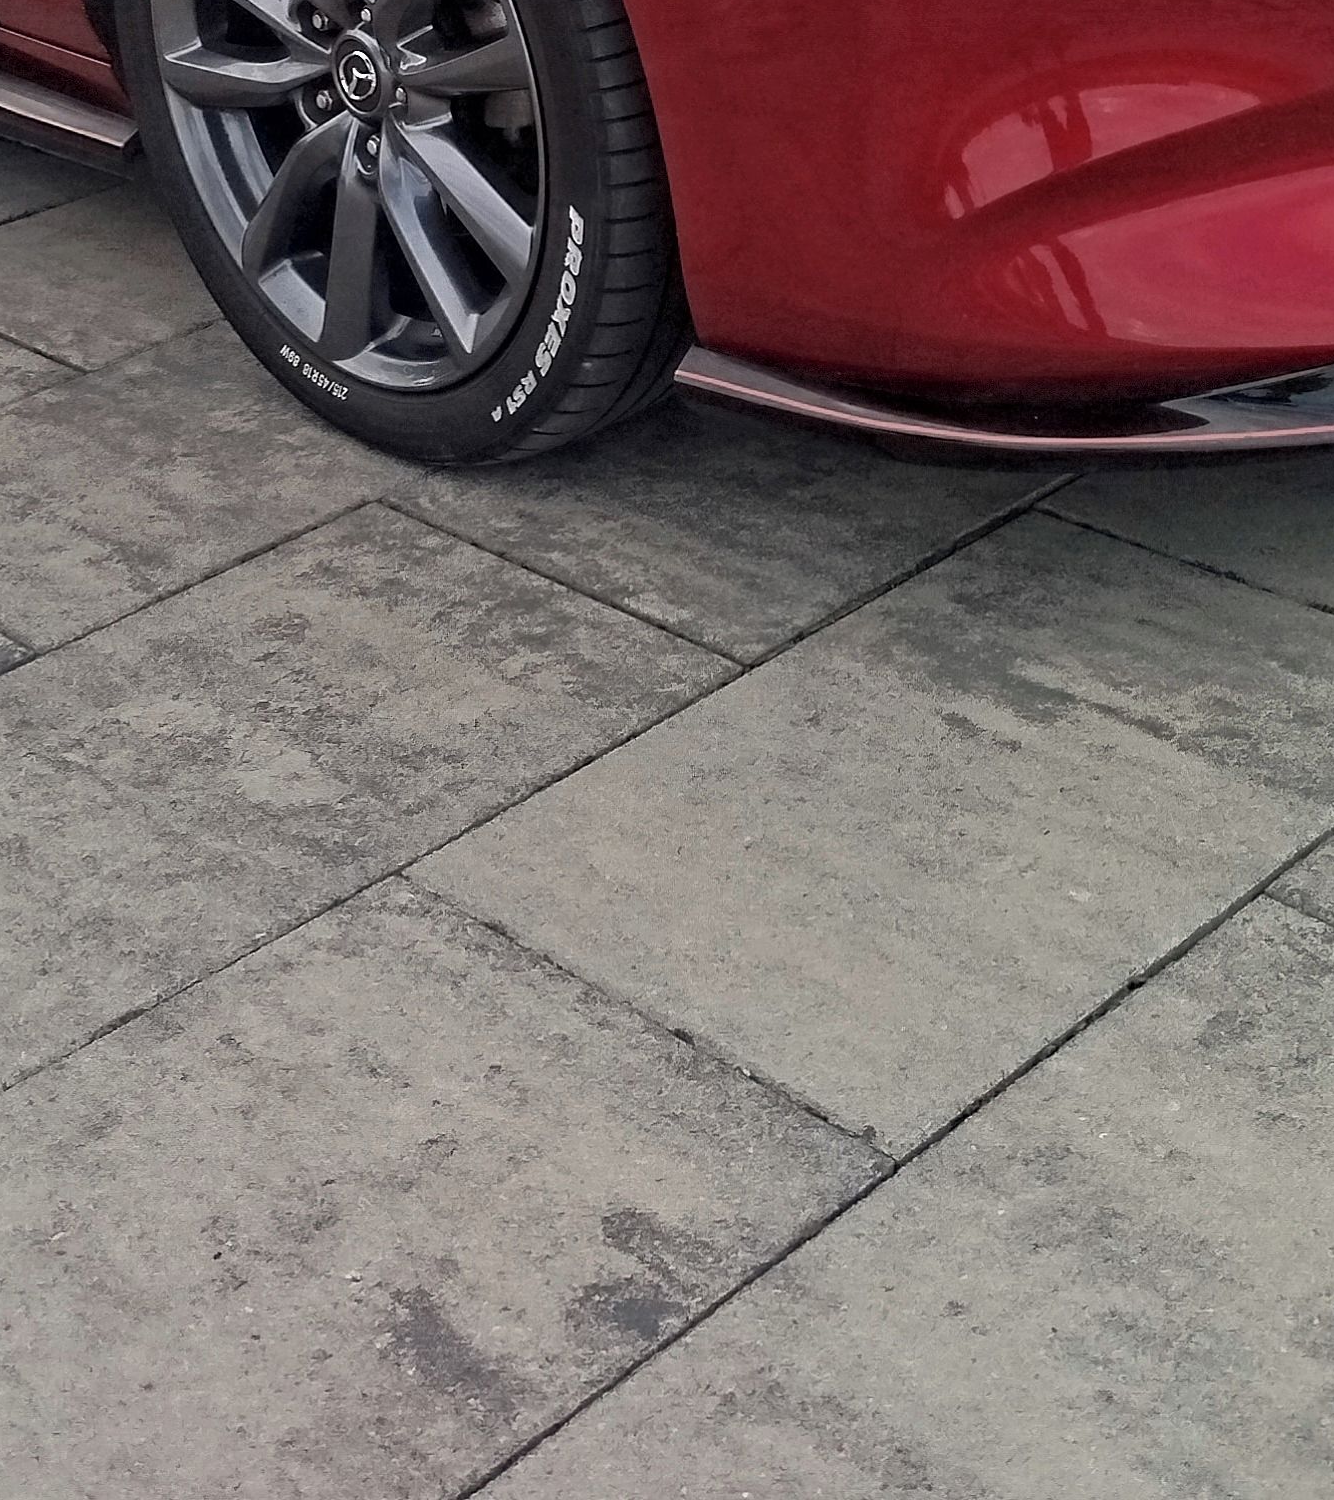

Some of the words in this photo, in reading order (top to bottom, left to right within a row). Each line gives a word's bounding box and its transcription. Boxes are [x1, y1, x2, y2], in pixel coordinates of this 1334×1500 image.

[535, 205, 584, 377] PROXES
[279, 344, 301, 367] 89W
[302, 363, 349, 400] 215/45R18
